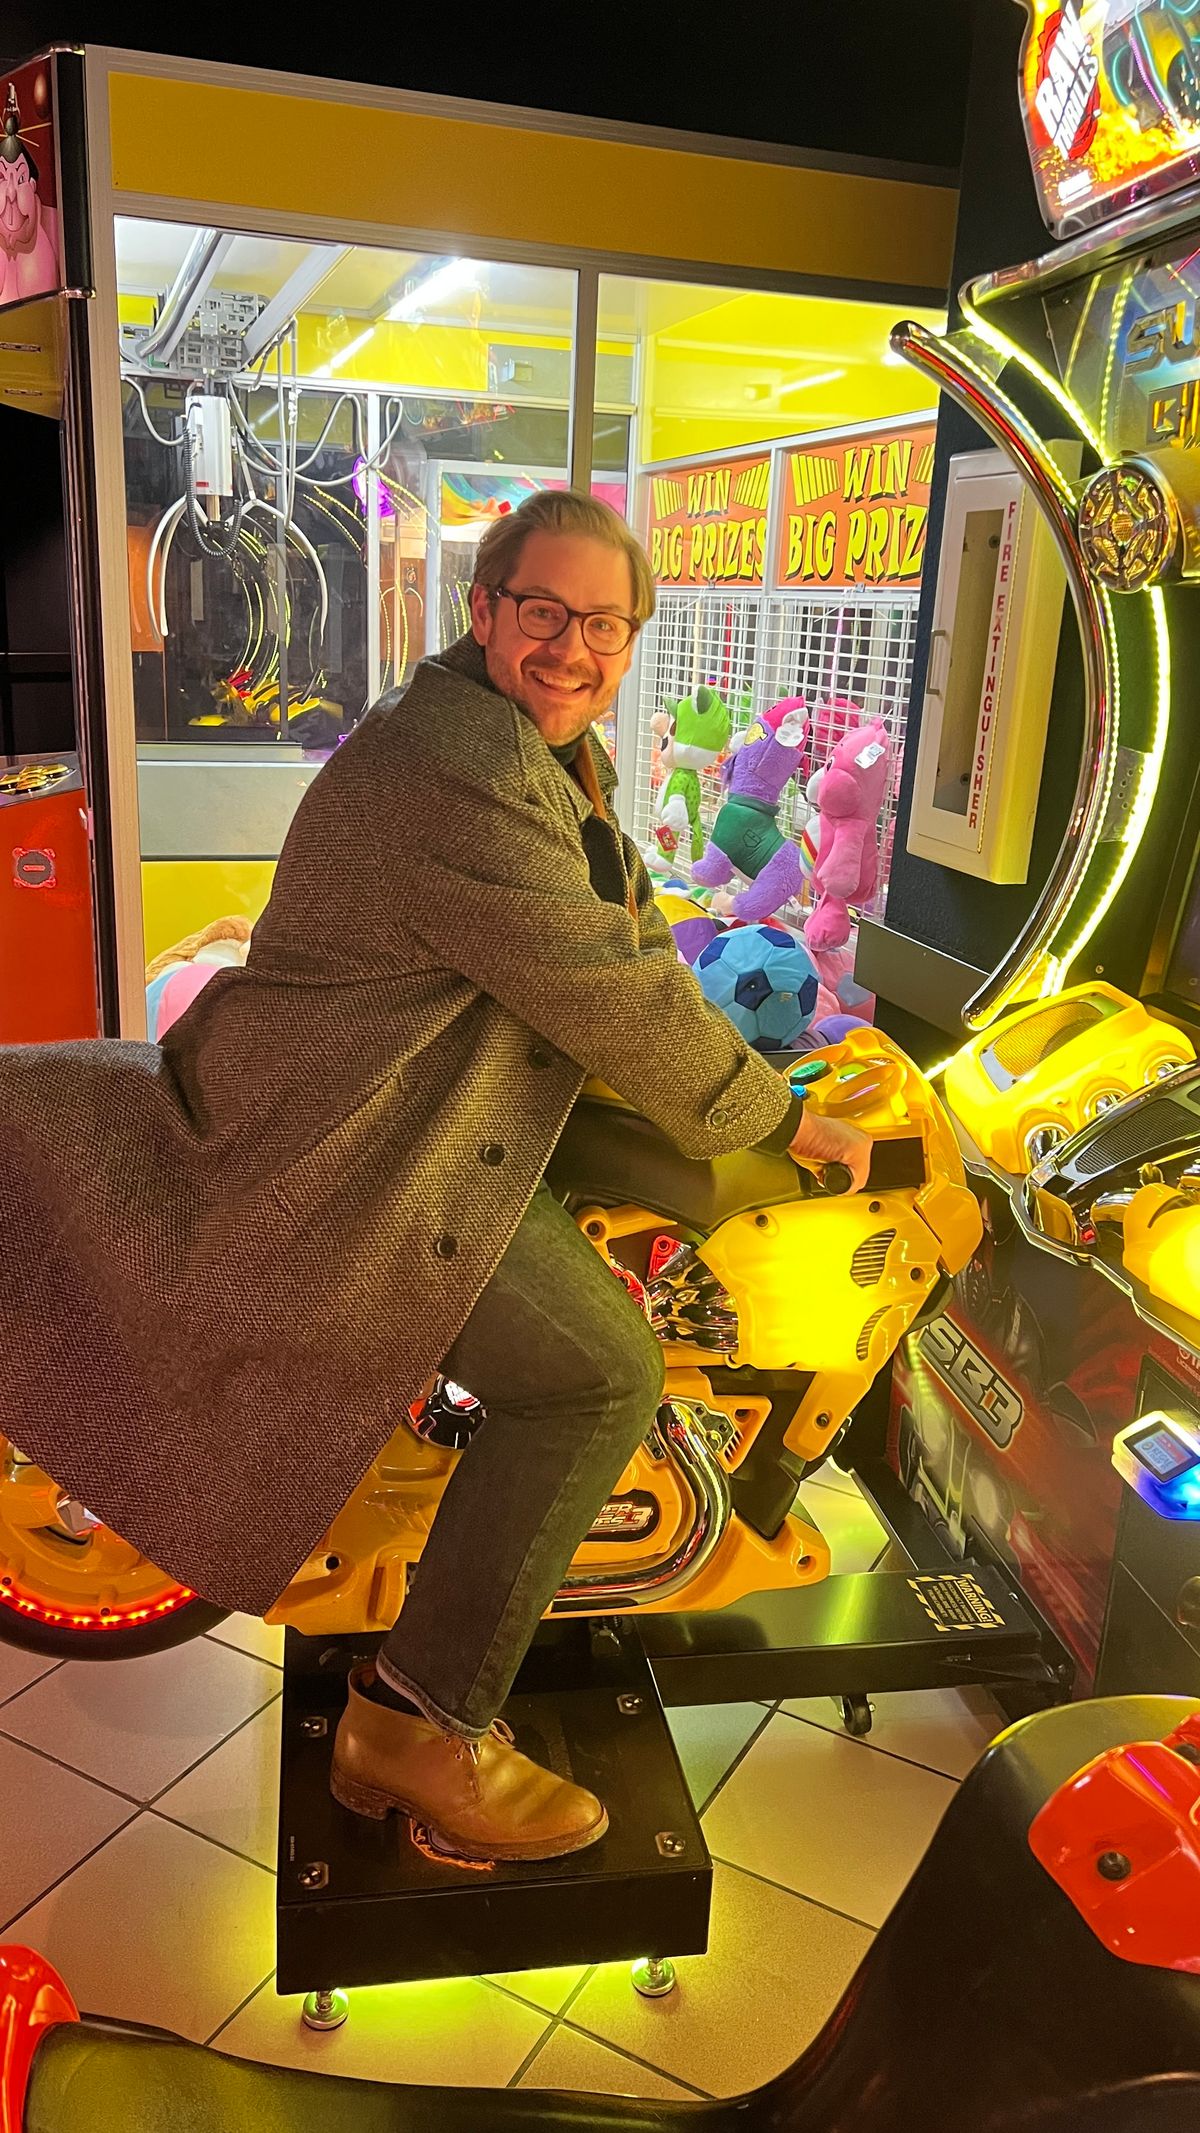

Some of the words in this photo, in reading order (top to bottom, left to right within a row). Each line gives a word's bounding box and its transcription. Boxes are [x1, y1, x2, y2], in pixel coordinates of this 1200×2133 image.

[1035, 0, 1088, 141] RAW
[1053, 44, 1099, 161] THRILLS
[1124, 299, 1200, 378] SU
[686, 468, 732, 518] WIN
[842, 440, 914, 503] WIN
[651, 524, 685, 581] BIG
[689, 516, 768, 582] PRIZES
[785, 510, 838, 582] BIG
[1000, 501, 1017, 583] FIRE
[968, 594, 1006, 829] EXTINGUISHER
[916, 1315, 1022, 1447] SB3
[957, 1579, 994, 1623] WARNING!
